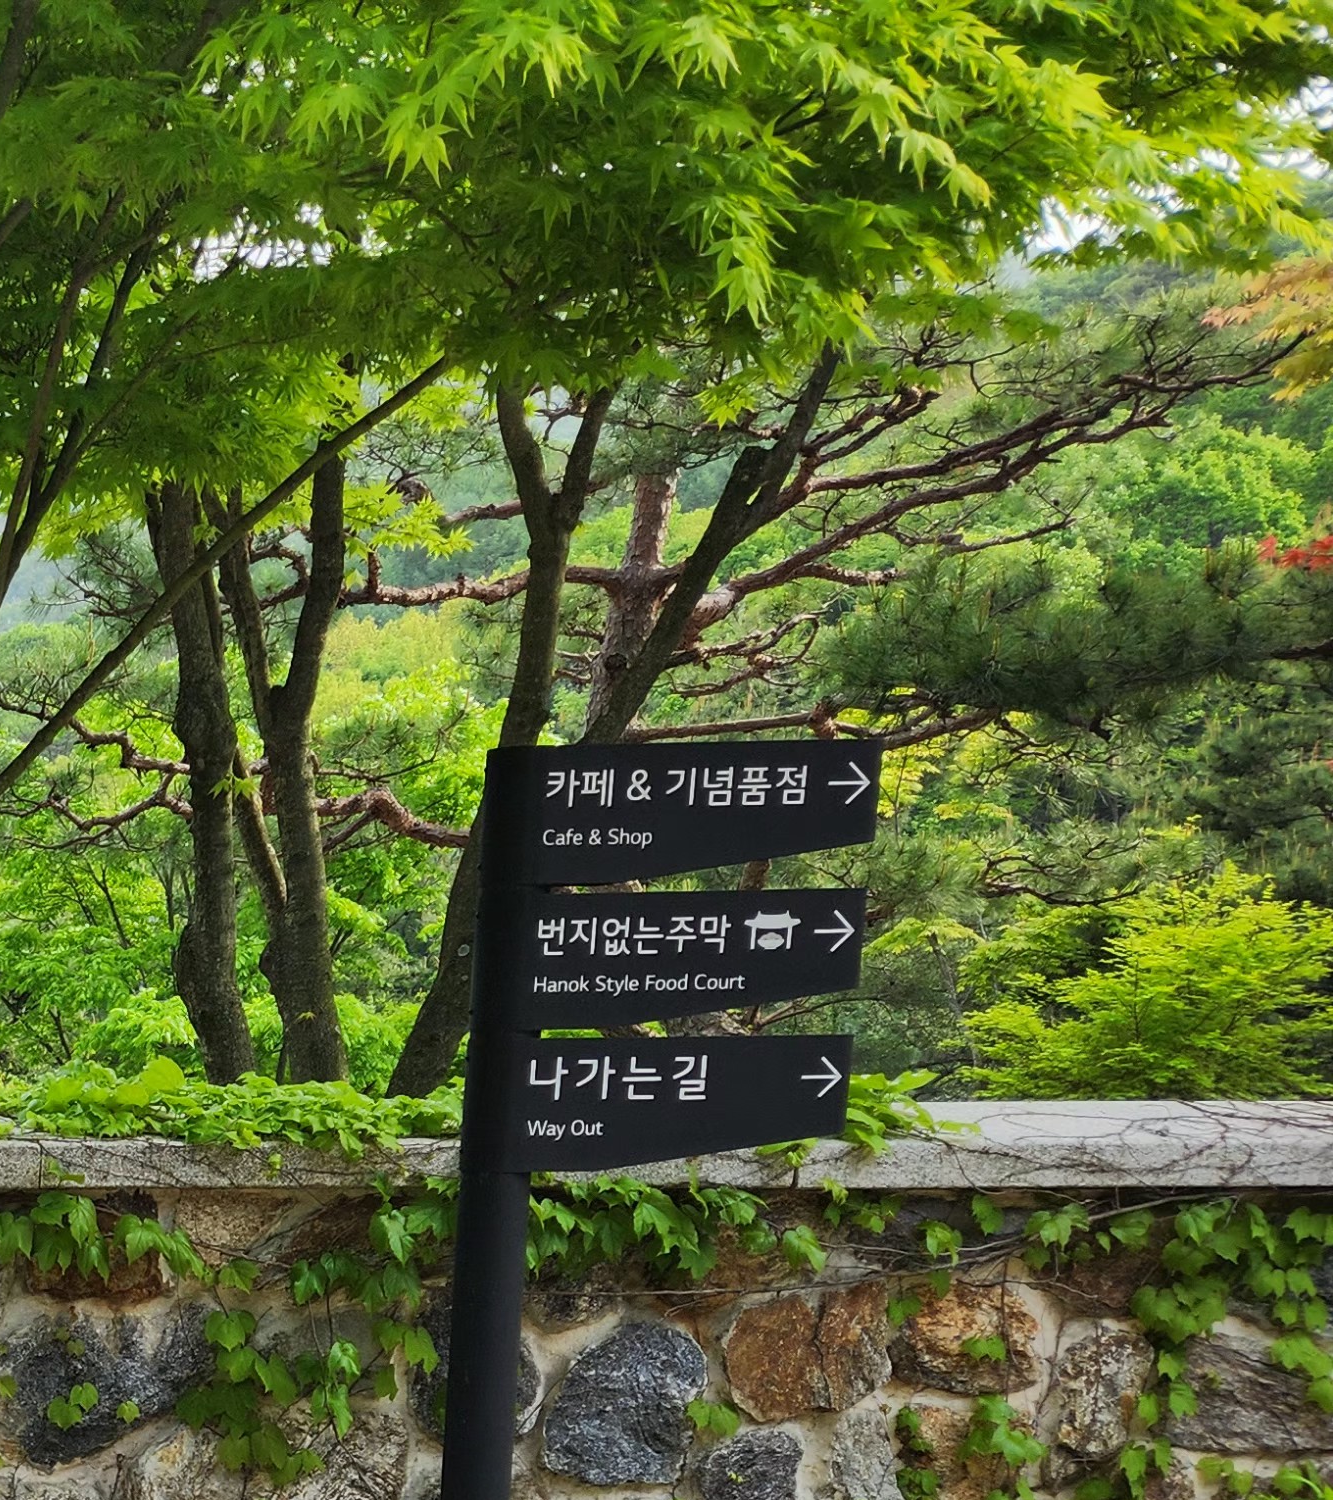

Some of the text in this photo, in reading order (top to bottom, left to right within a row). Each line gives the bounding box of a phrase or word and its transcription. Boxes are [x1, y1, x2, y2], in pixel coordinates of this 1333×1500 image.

[546, 764, 808, 808] 카페 & 기념품점
[542, 827, 653, 850] Cafe & Shop
[537, 914, 732, 956] 번지없는주막
[533, 973, 746, 997] Hanok Style Food Court
[527, 1119, 604, 1141] Way Out
